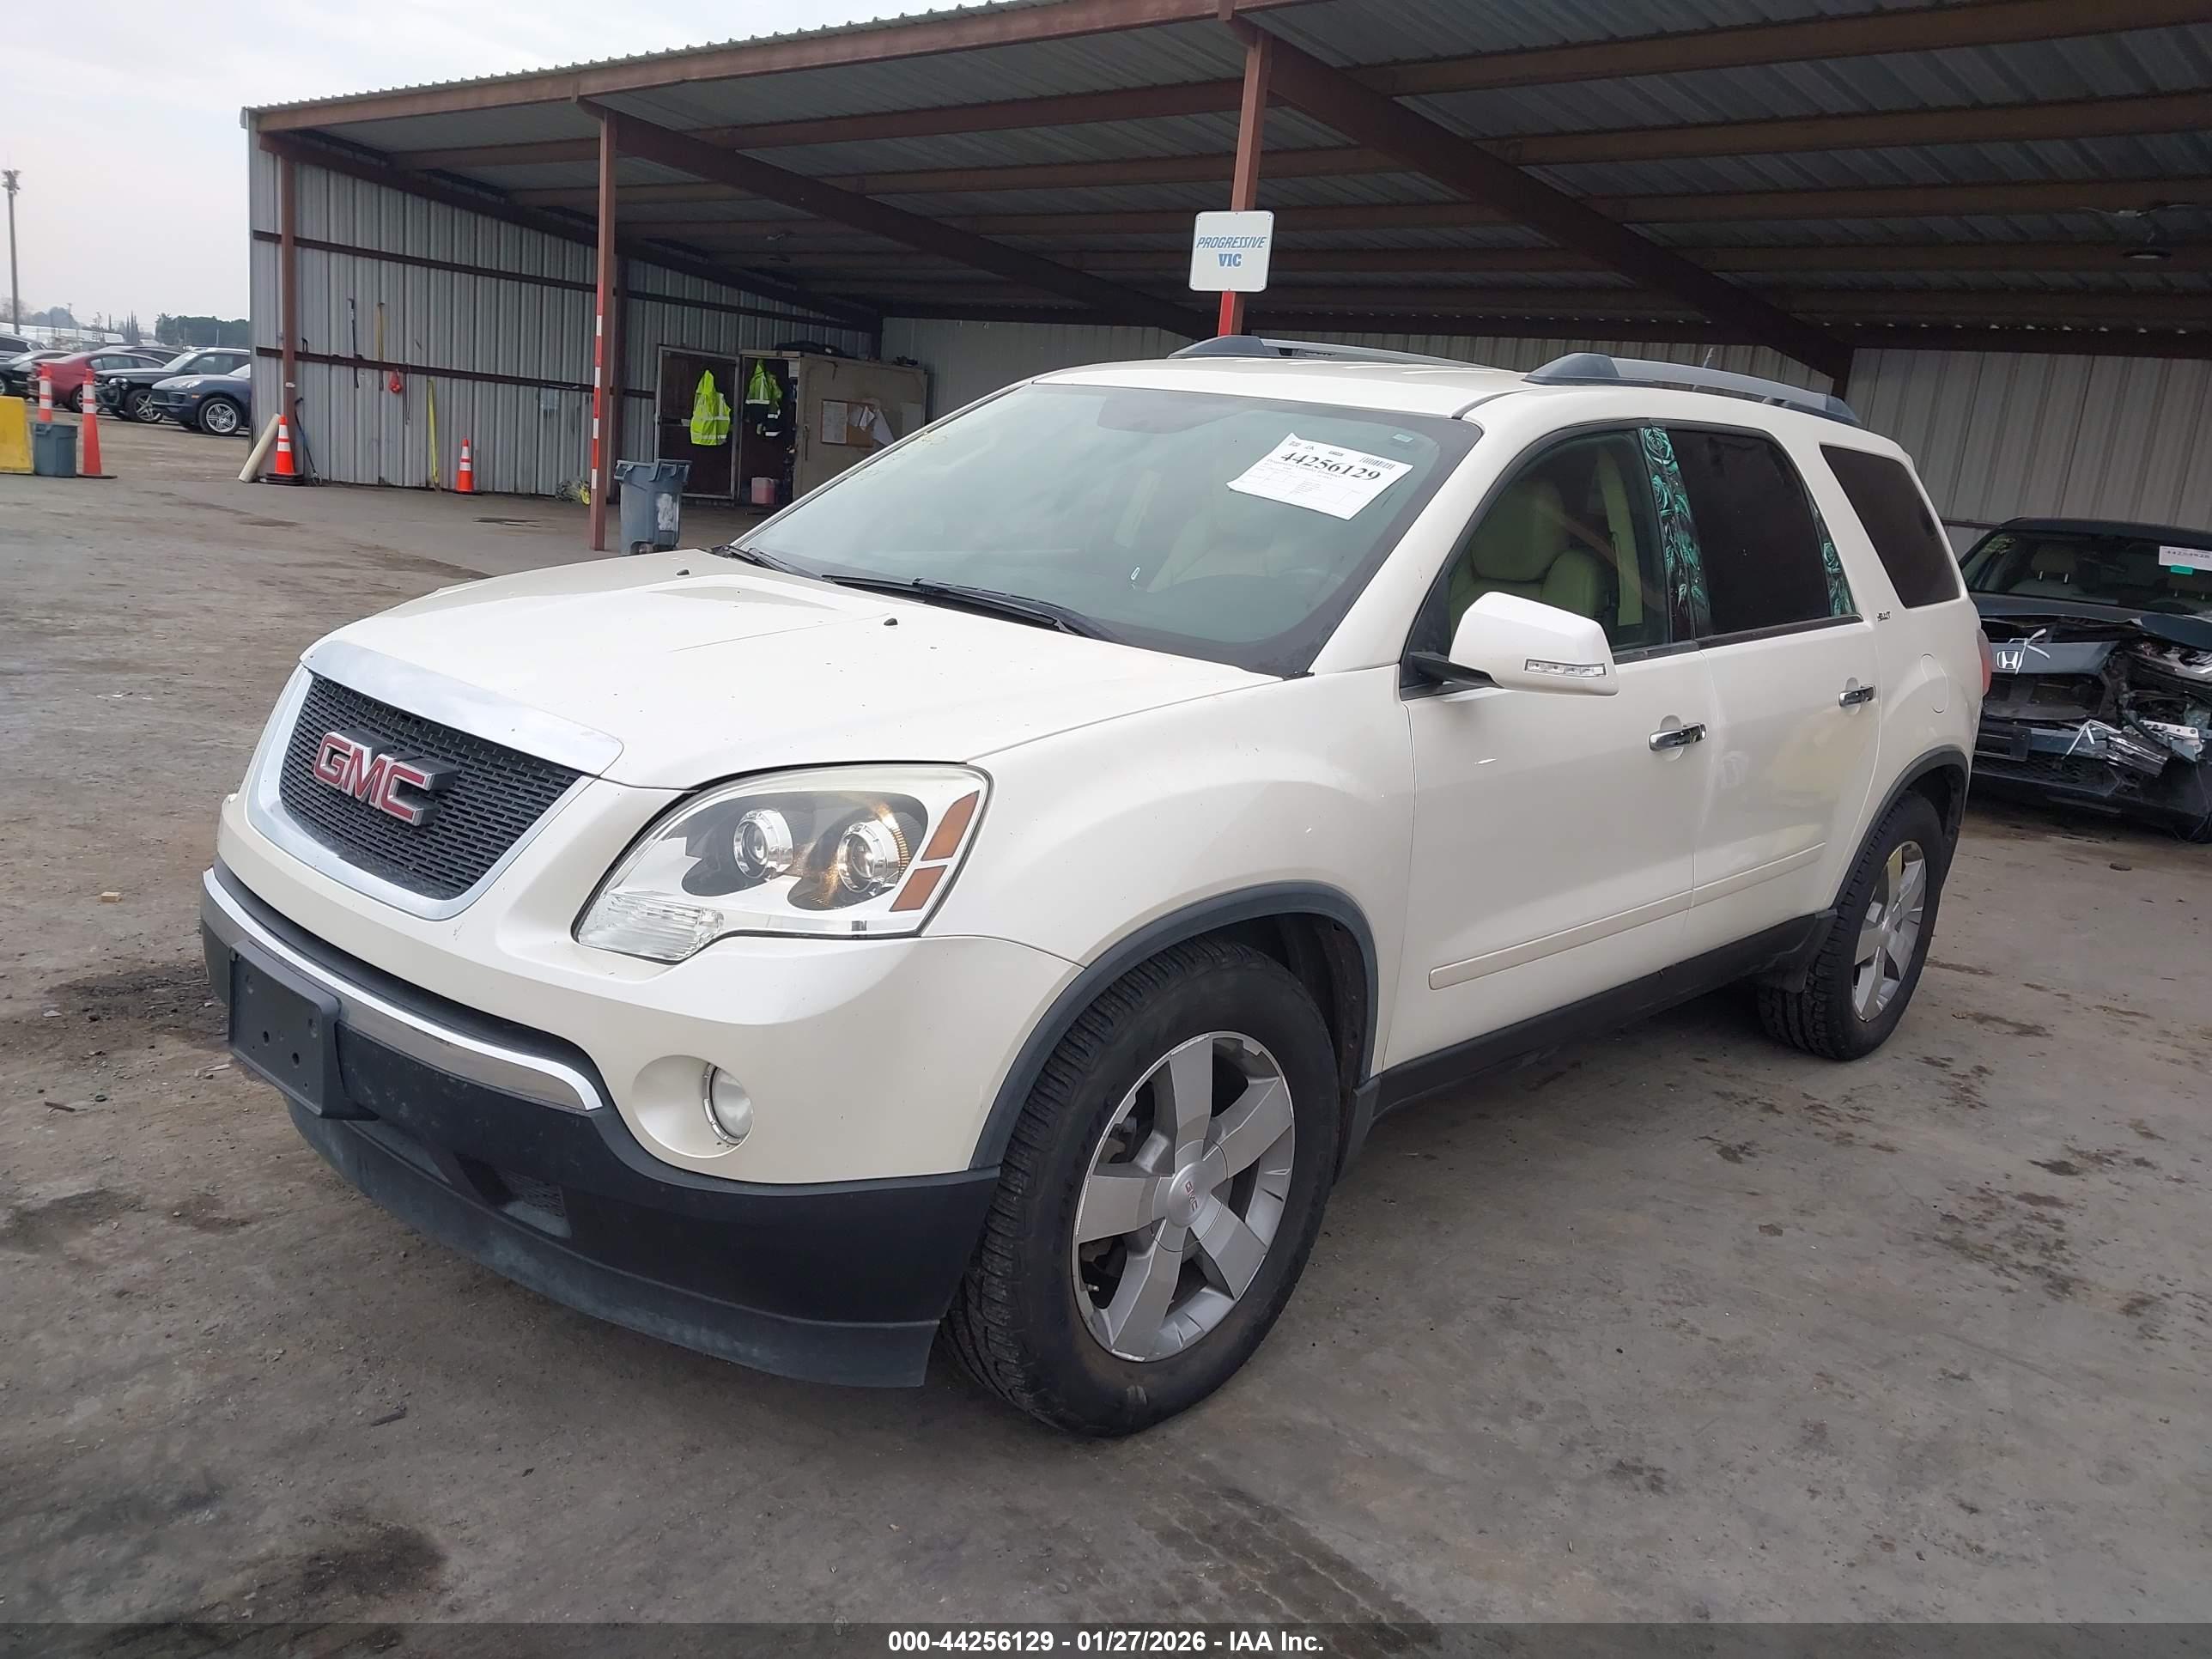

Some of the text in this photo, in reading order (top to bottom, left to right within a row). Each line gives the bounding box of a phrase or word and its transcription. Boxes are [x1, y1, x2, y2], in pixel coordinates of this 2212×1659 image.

[1196, 236, 1267, 249] PROGRESSIVE
[1218, 253, 1243, 268] VIC
[1280, 452, 1381, 480] 44256129
[313, 731, 434, 827] GMC
[1185, 1181, 1198, 1212] GMC
